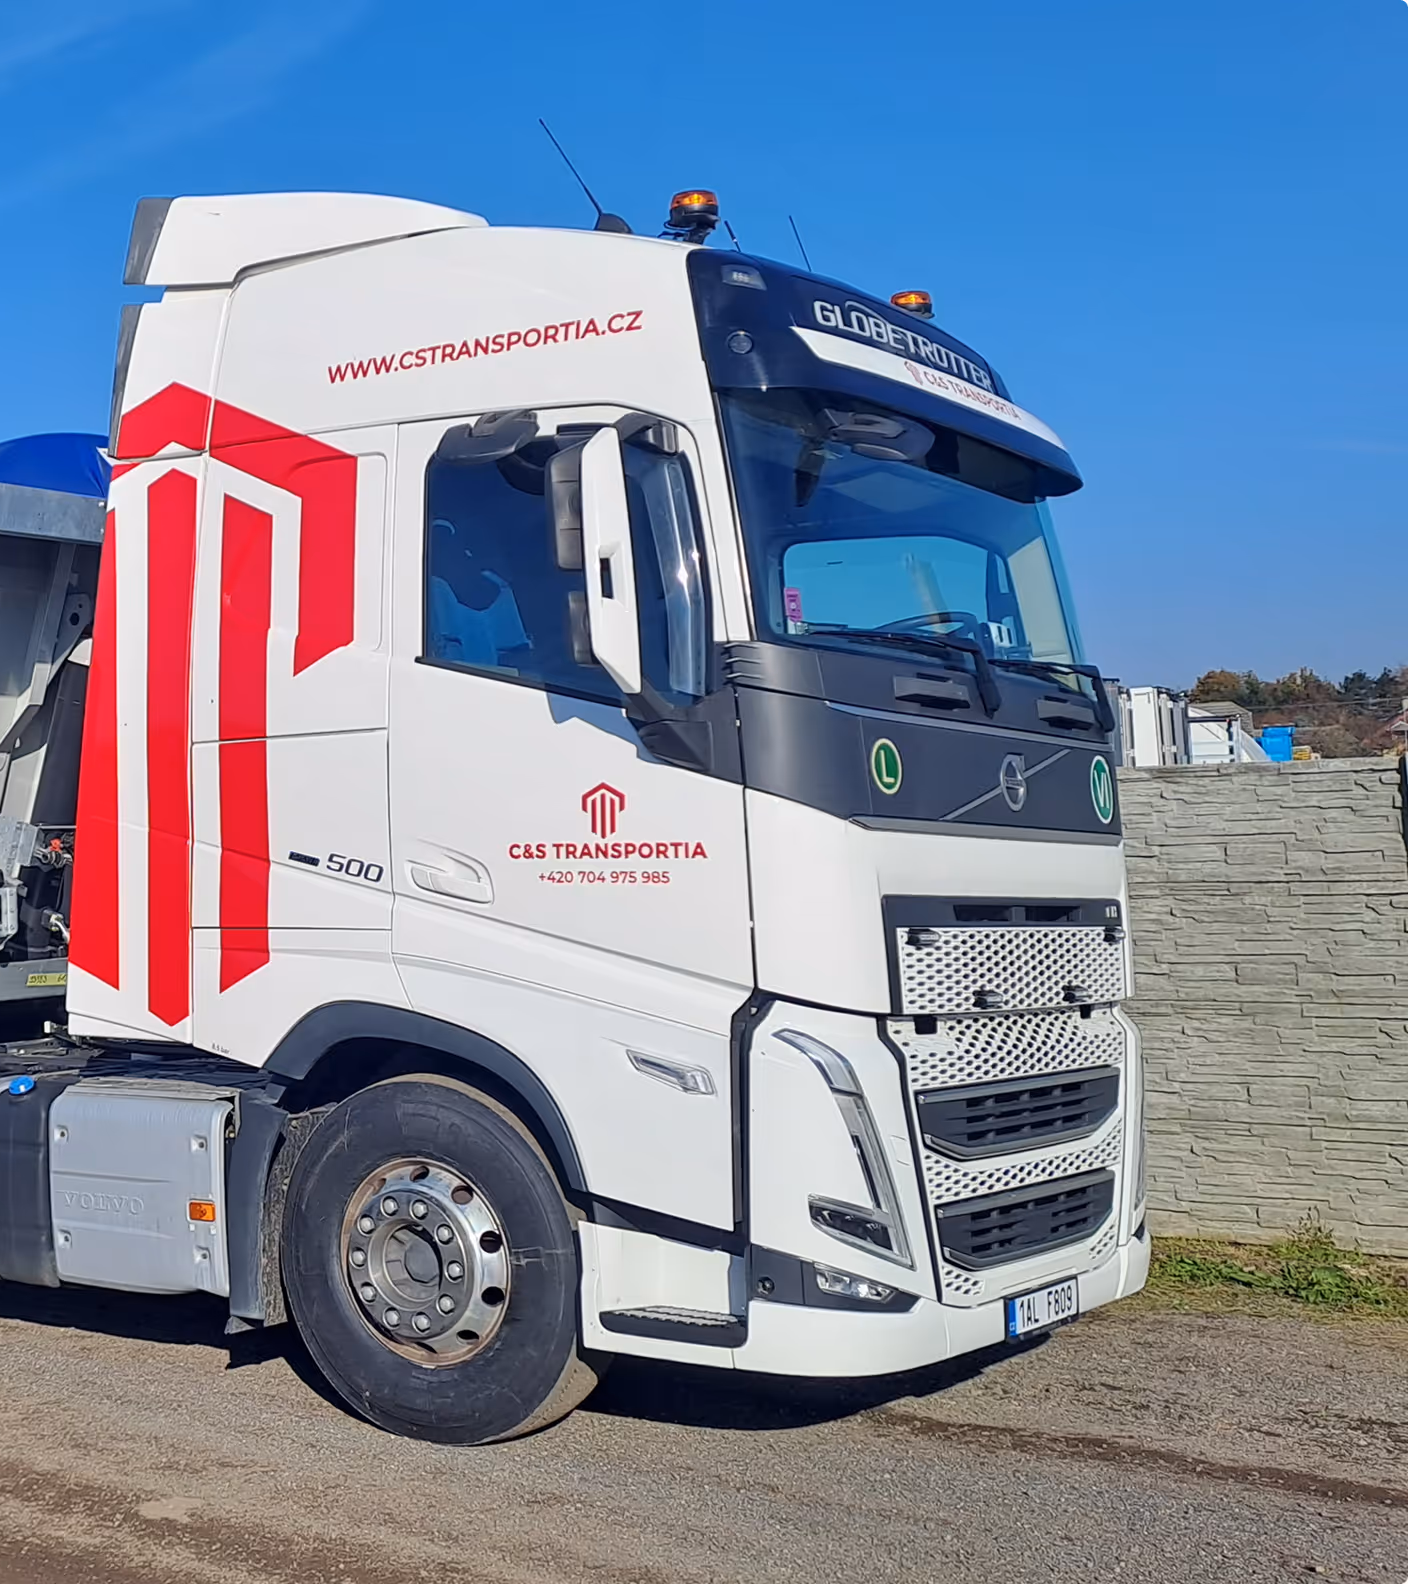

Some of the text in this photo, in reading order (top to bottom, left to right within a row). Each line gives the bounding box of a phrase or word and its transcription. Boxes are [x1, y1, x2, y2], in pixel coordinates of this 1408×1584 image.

[327, 309, 644, 384] WWW.CSTRANSPORTIA.CZ
[813, 299, 994, 394] GLOBETROTTER
[879, 749, 895, 783] L
[508, 841, 709, 860] C&S TRANSPORTIA
[326, 852, 385, 883] 500
[538, 870, 671, 884] +420 704 975 985
[63, 1189, 145, 1216] VOLVO
[1019, 1284, 1073, 1328] 1AL F809
